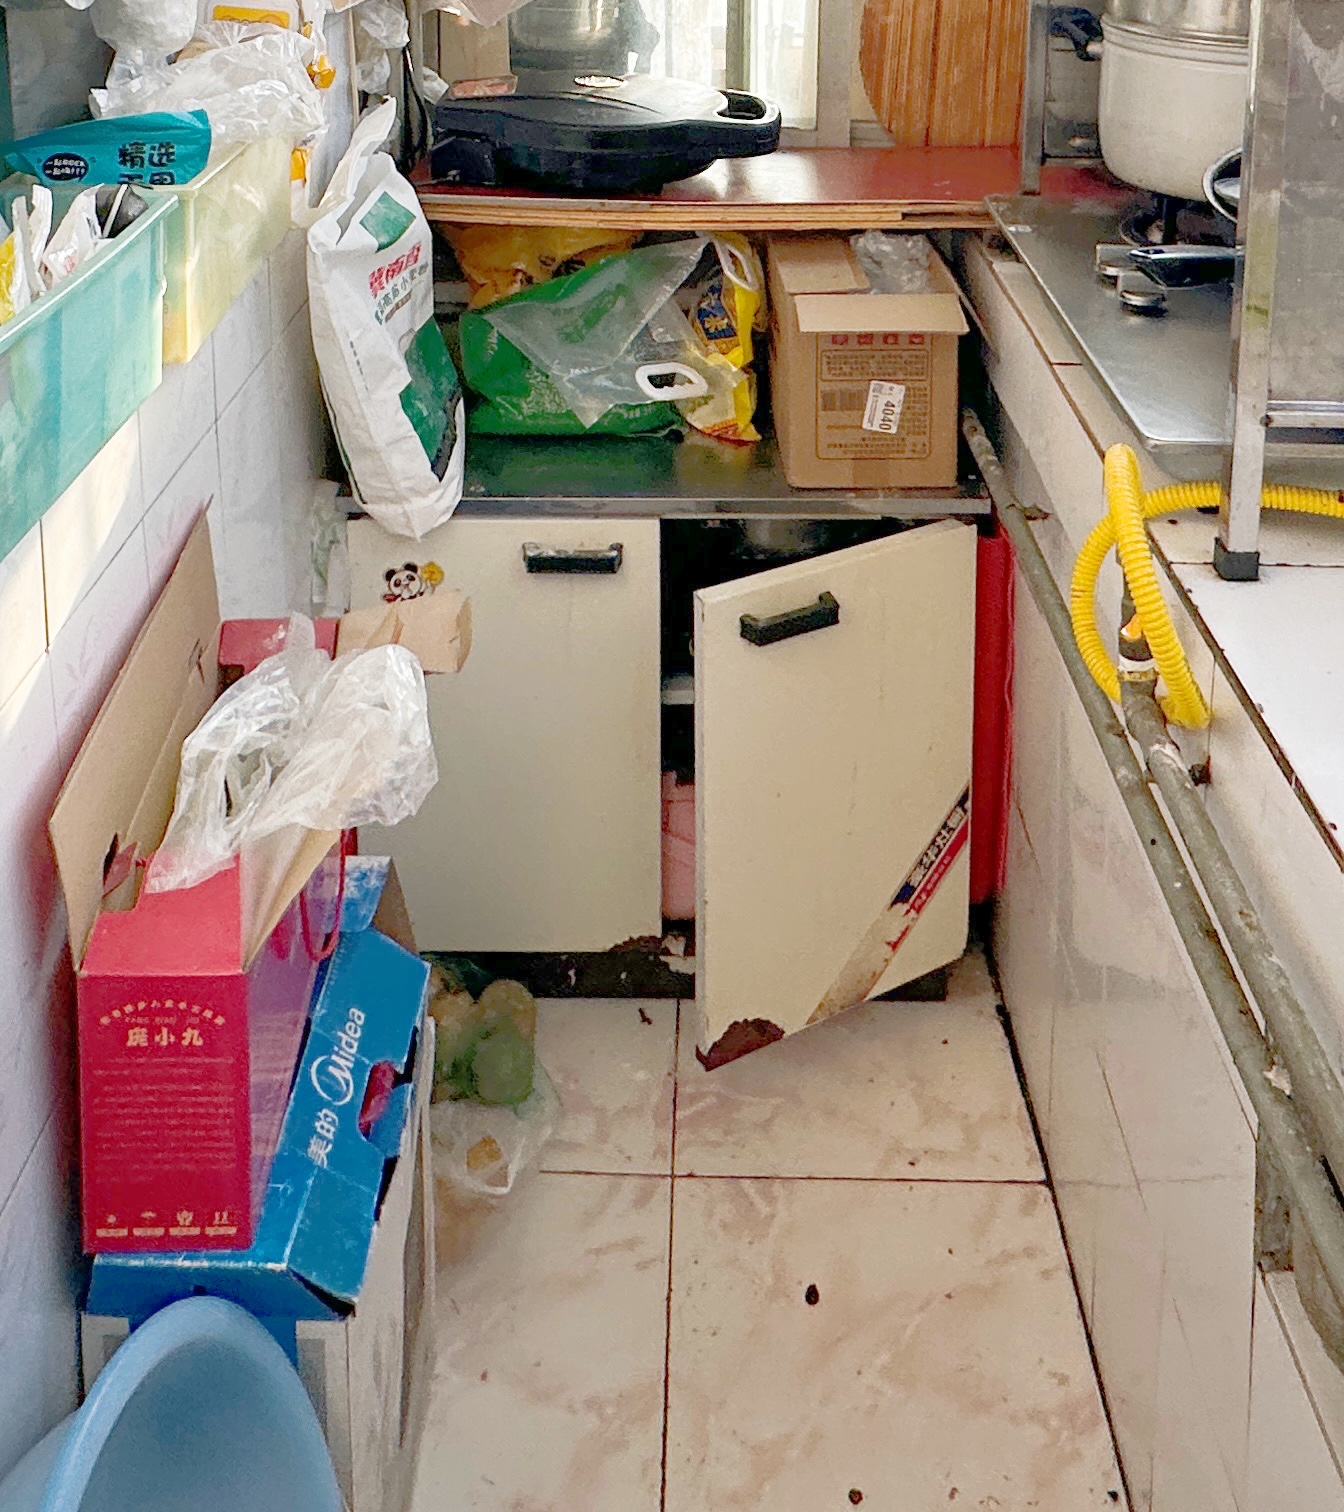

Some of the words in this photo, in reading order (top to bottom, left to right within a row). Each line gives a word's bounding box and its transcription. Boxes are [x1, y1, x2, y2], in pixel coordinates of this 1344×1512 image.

[118, 141, 177, 169] 精选
[879, 400, 896, 431] 4040
[320, 1007, 366, 1097] Midea
[307, 1109, 339, 1168] 美的
